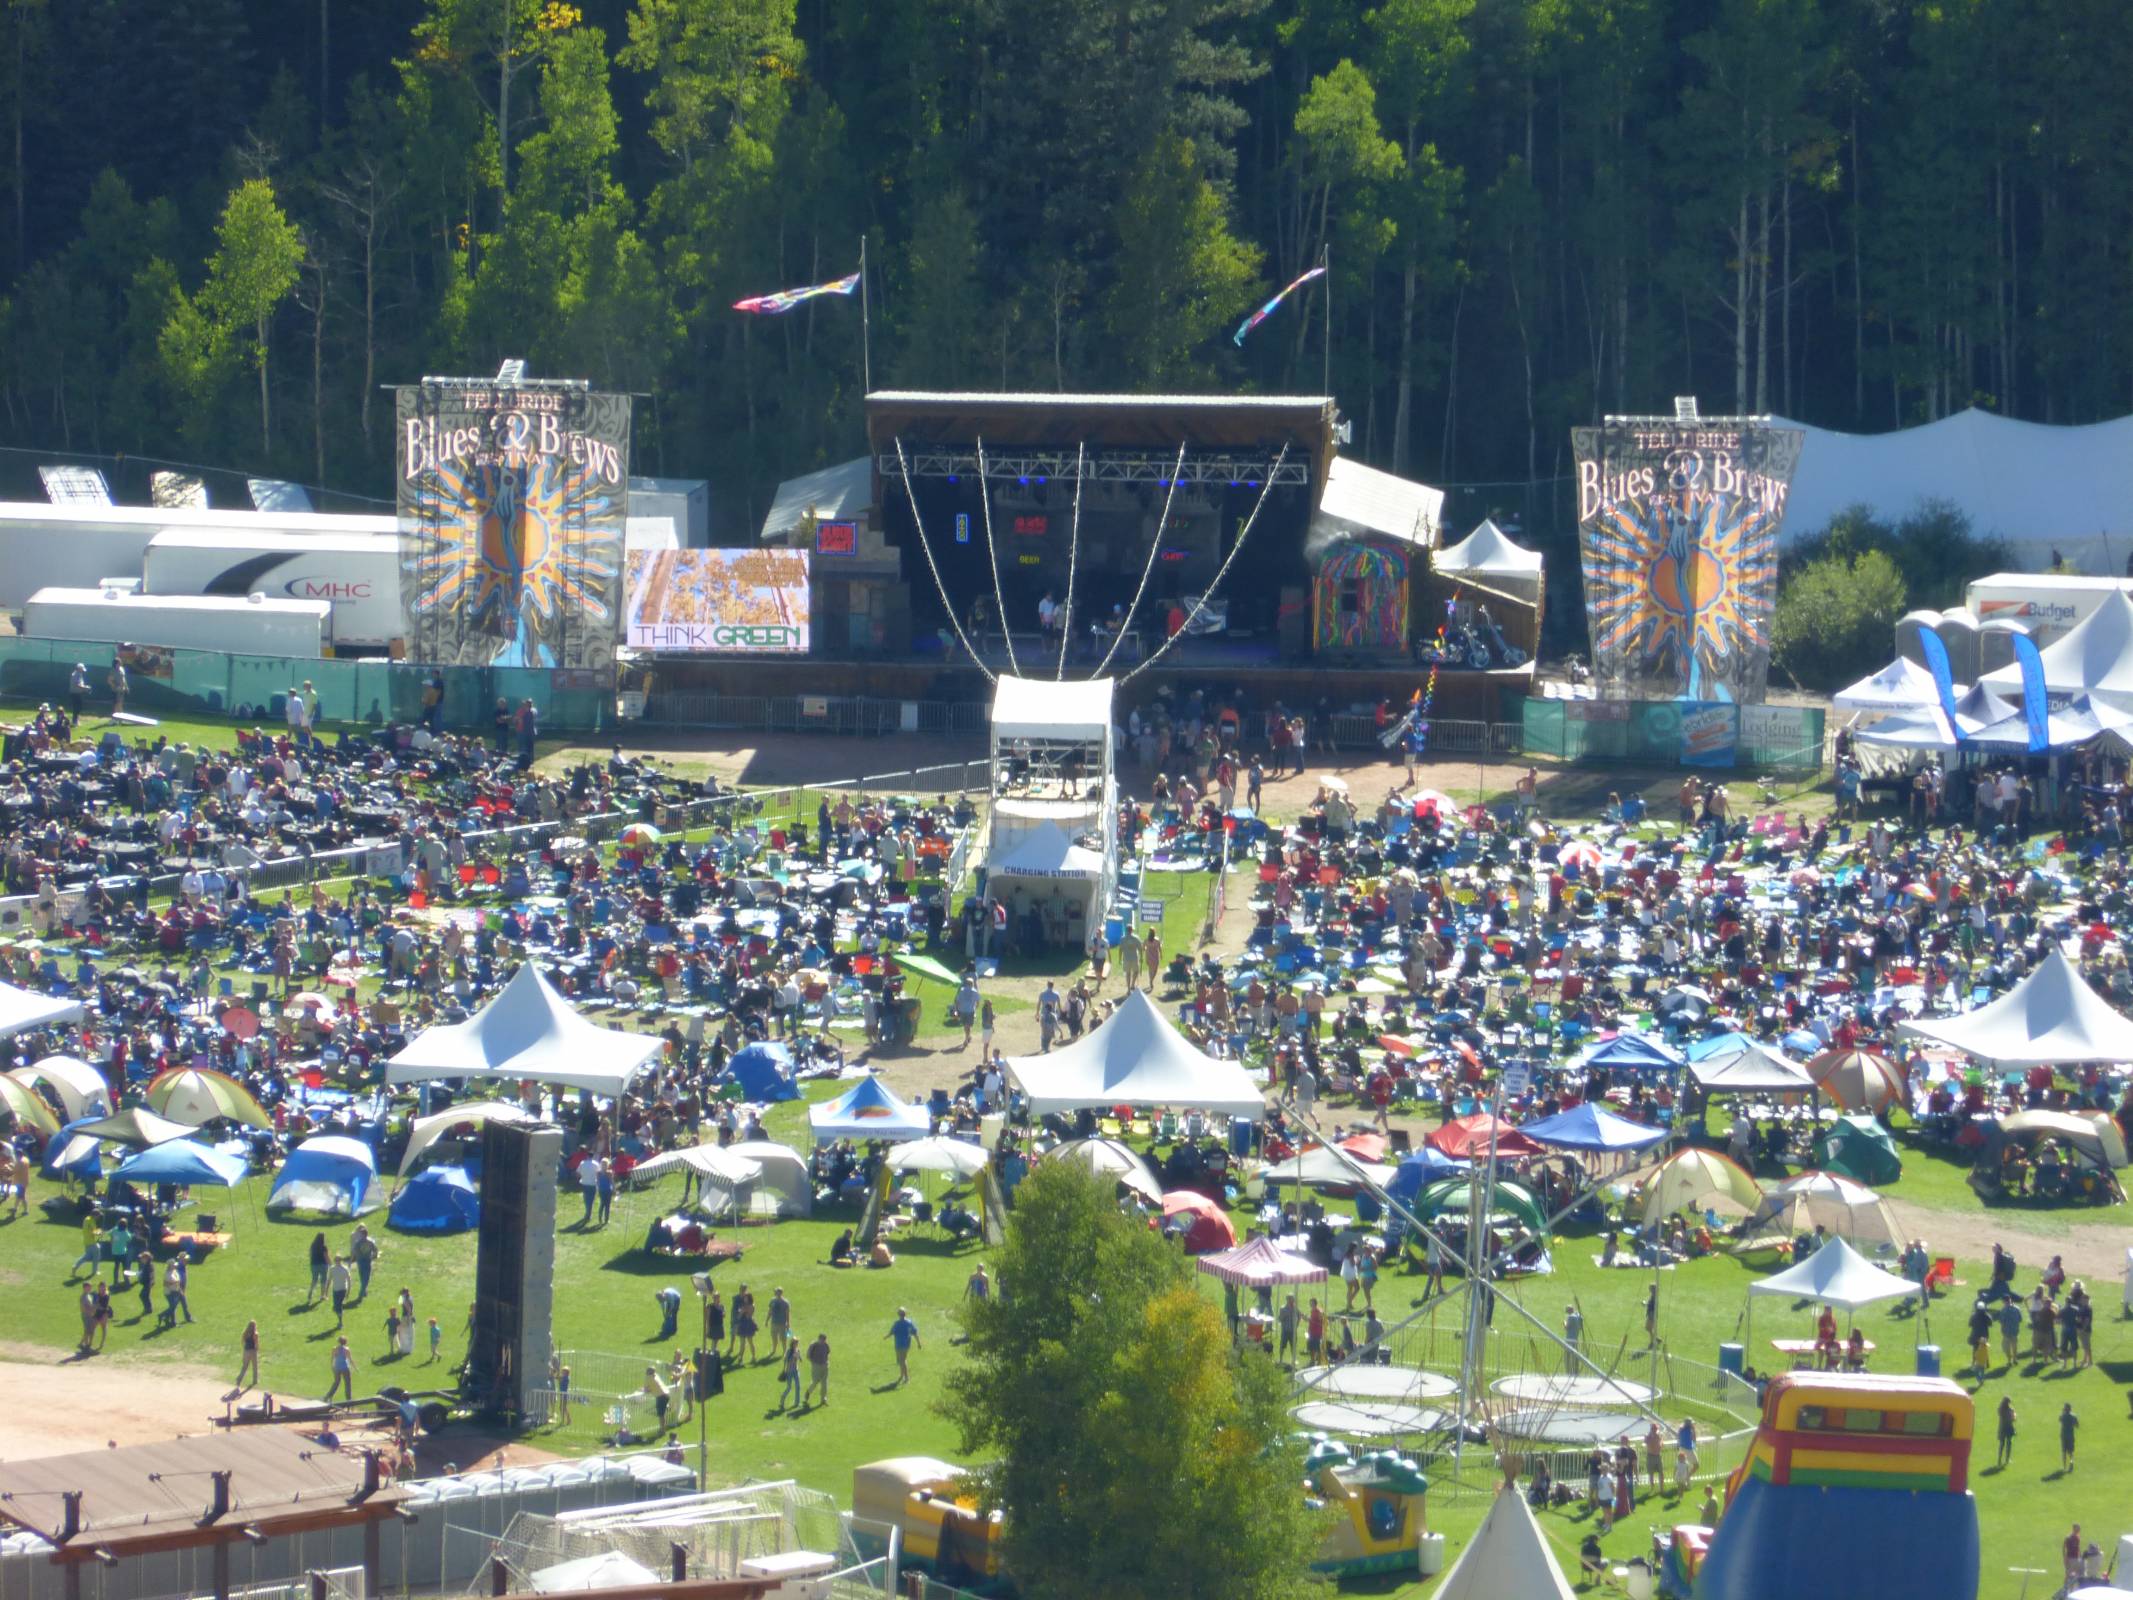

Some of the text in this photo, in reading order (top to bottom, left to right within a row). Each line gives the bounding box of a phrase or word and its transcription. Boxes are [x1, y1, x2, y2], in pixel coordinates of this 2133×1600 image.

[406, 415, 481, 480] Blues
[539, 411, 620, 484] Brews
[1580, 457, 1654, 522] Blues
[1713, 449, 1788, 520] Brews
[305, 582, 371, 598] MHC
[2028, 601, 2076, 622] Budget
[635, 624, 801, 646] THINK GREEN
[1003, 865, 1087, 878] CHARGING STATION
